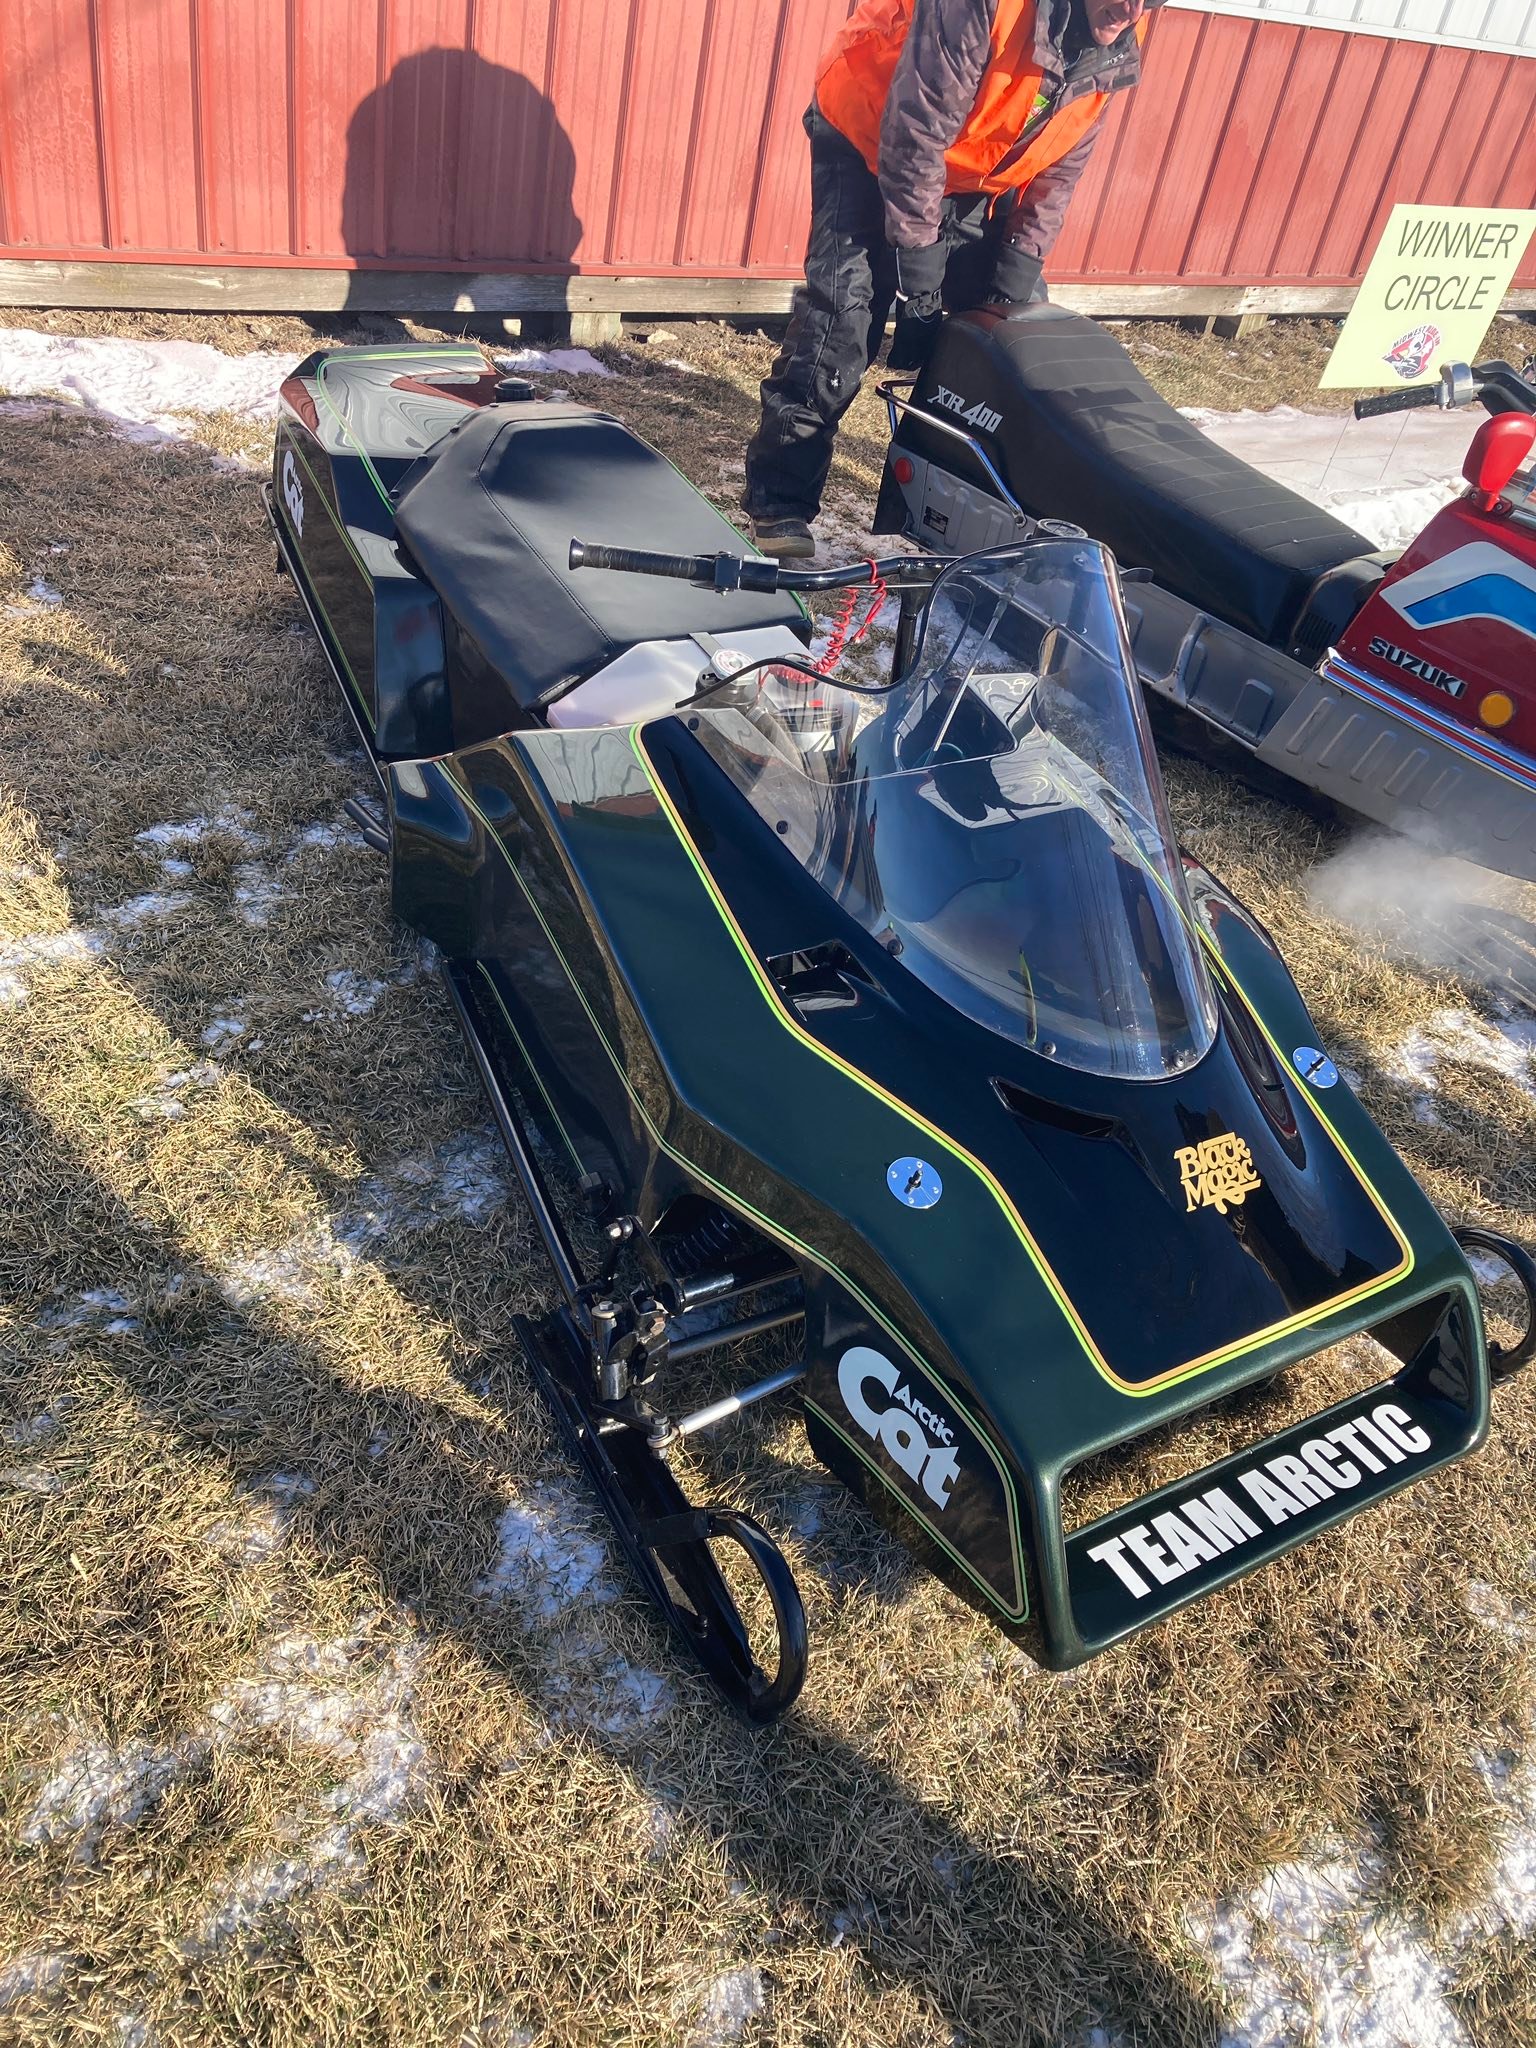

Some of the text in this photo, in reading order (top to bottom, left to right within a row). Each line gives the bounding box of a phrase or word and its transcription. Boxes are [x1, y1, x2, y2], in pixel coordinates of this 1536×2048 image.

[1397, 219, 1519, 259] WINNER
[1384, 275, 1496, 311] CIRCLE
[1368, 636, 1468, 699] SUZUKI
[1174, 1132, 1251, 1180] Black
[1181, 1158, 1262, 1214] Magic
[837, 1346, 961, 1511] Cat
[893, 1384, 954, 1446] Arctic
[1086, 1404, 1432, 1598] TEAM ARCTIC
